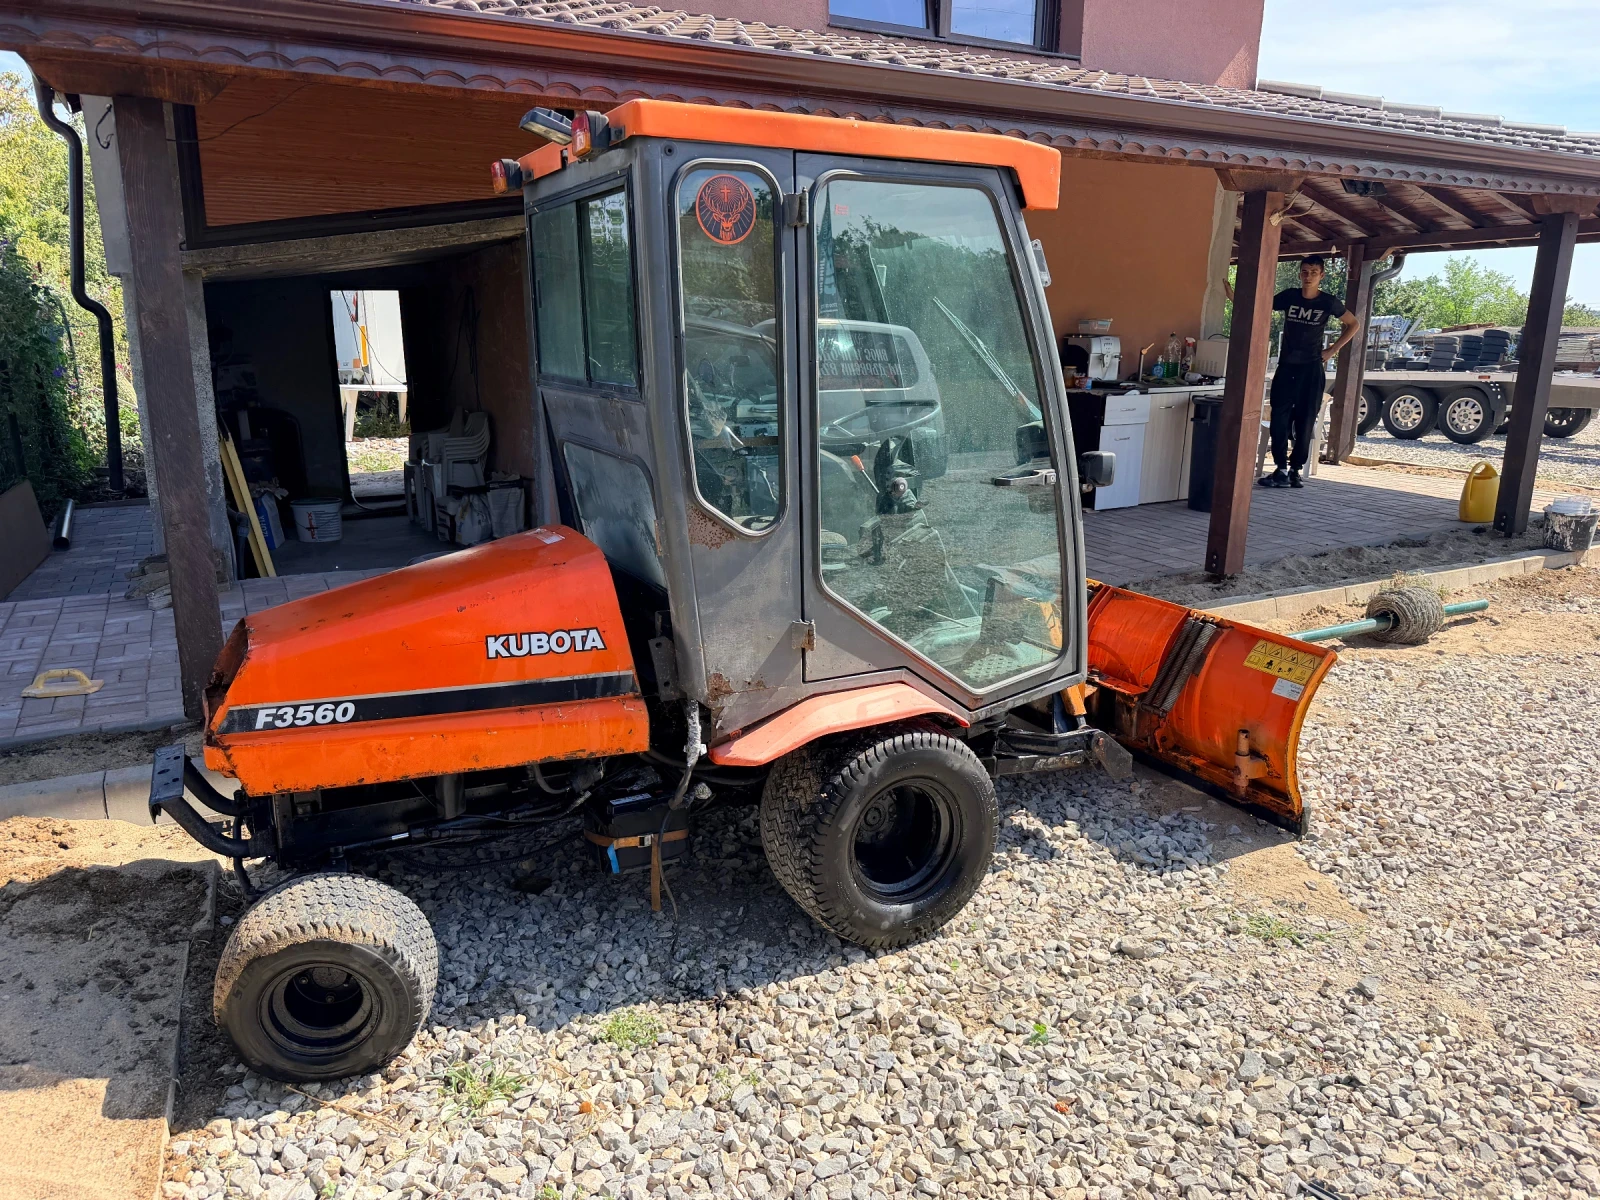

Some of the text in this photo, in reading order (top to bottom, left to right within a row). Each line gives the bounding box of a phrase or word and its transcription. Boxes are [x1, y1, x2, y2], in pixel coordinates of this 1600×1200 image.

[1288, 305, 1324, 321] EM7
[486, 627, 606, 660] KUBOTA
[254, 701, 356, 731] F3560
